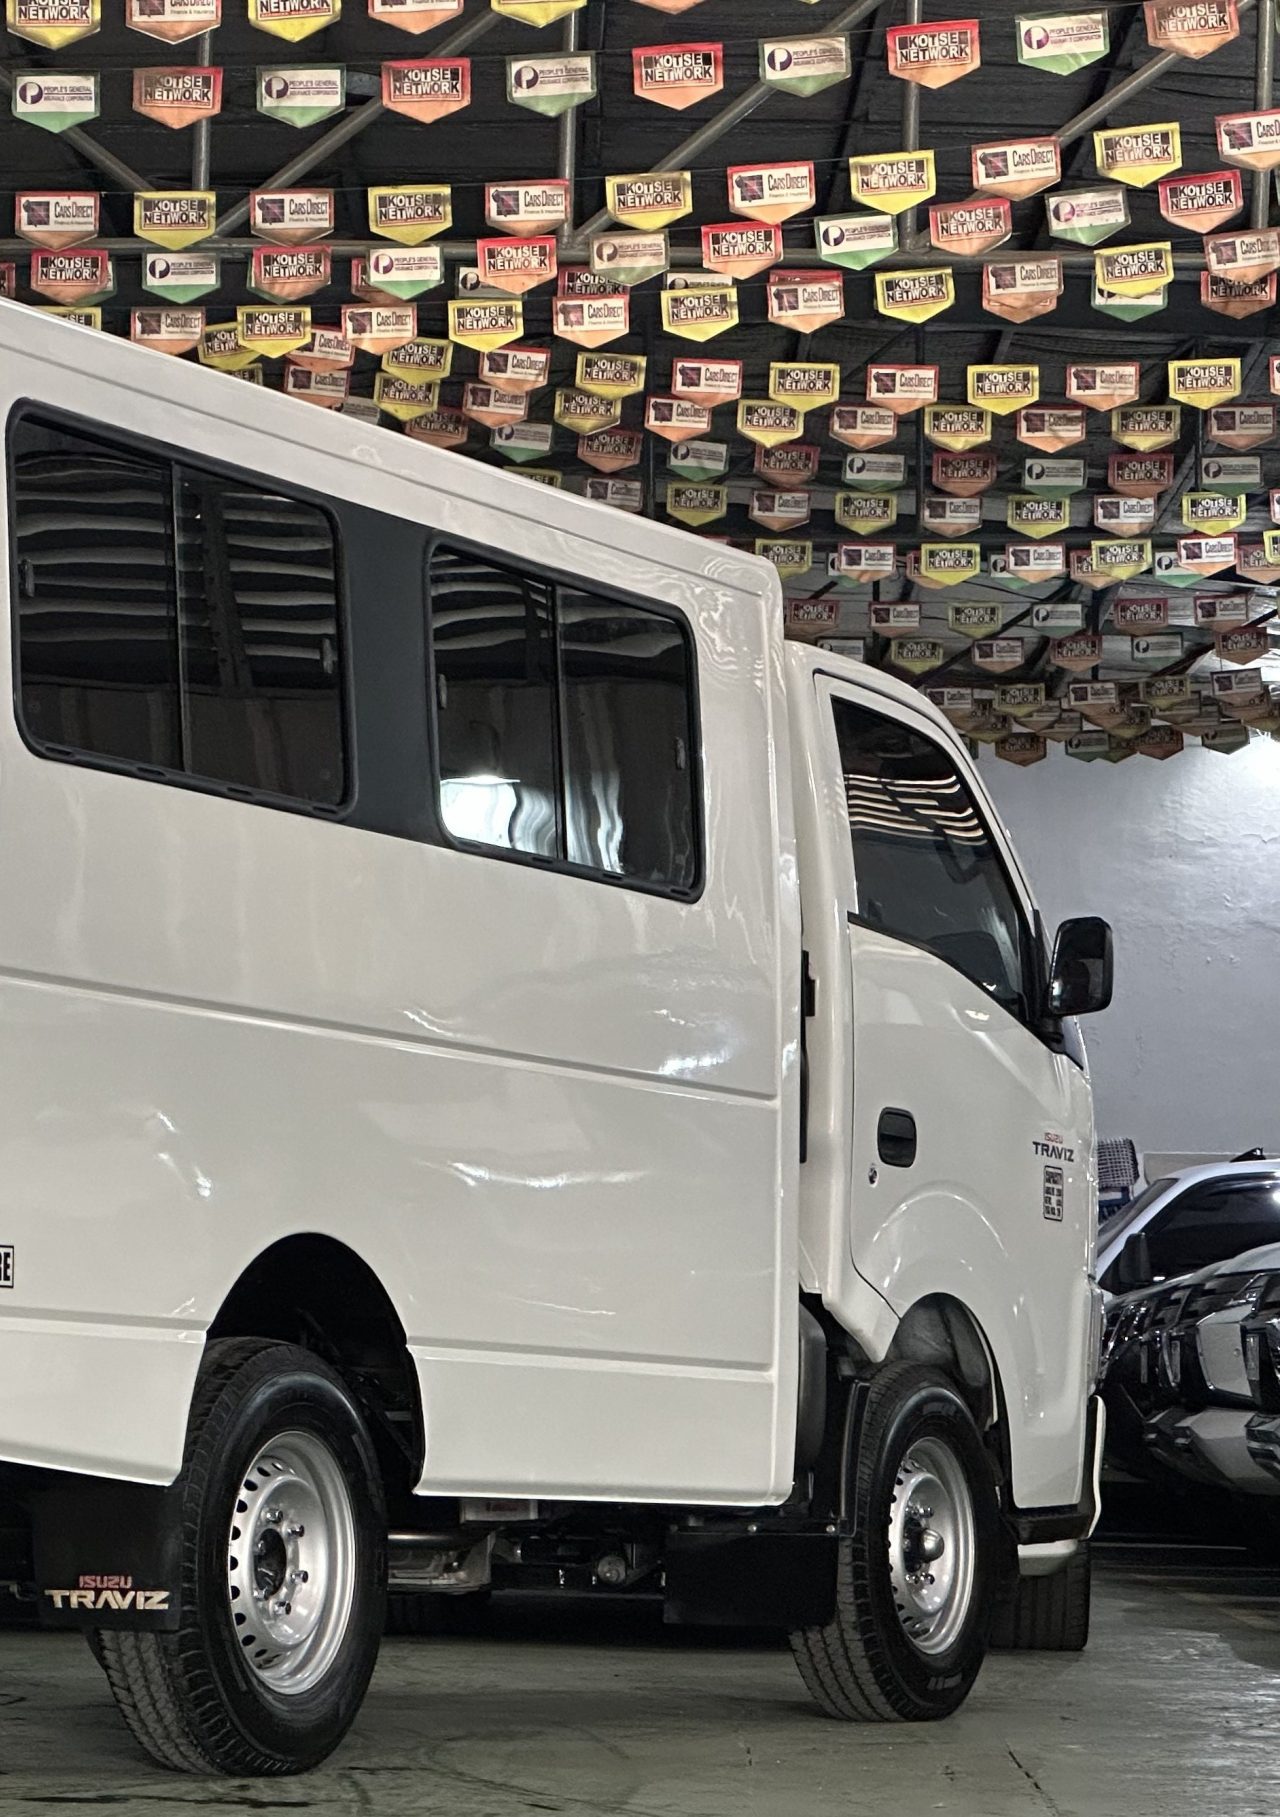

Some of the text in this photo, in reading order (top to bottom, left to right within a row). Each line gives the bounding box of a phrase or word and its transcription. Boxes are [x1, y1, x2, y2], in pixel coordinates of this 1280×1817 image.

[19, 5, 89, 19] NETWORK
[259, 0, 329, 13] NETWORK
[1168, 3, 1217, 18] KOTSE
[1158, 14, 1228, 31] NETWORK
[908, 32, 957, 47] KOTSE
[654, 54, 702, 67] KOTSE
[900, 46, 967, 63] NETWORK
[403, 68, 451, 82] KOTSE
[645, 66, 712, 82] NETWORK
[154, 75, 202, 87] KOTSE
[145, 88, 210, 100] NETWORK
[393, 82, 459, 96] NETWORK
[1113, 133, 1161, 148] KOTSE
[1105, 146, 1170, 162] NETWORK
[871, 161, 915, 175] KOTSE
[861, 173, 925, 188] NETWORK
[626, 181, 672, 194] KOTSE
[1178, 182, 1224, 197] KOTSE
[154, 200, 198, 212] KOTSE
[387, 193, 431, 207] KOTSE
[617, 192, 681, 207] NETWORK
[1171, 194, 1232, 209] NETWORK
[144, 211, 206, 223] NETWORK
[379, 204, 442, 220] NETWORK
[950, 208, 993, 223] KOTSE
[941, 218, 1002, 235] NETWORK
[721, 232, 763, 243] KOTSE
[496, 245, 539, 257] KOTSE
[713, 242, 772, 255] NETWORK
[48, 257, 91, 268] KOTSE
[272, 254, 315, 265] KOTSE
[488, 256, 547, 270] NETWORK
[1113, 251, 1155, 264] KOTSE
[41, 268, 98, 279] NETWORK
[263, 264, 322, 277] NETWORK
[1106, 262, 1163, 277] NETWORK
[894, 278, 936, 290] KOTSE
[1211, 284, 1267, 297] NETWORK
[678, 295, 719, 308] KOTSE
[886, 288, 944, 302] NETWORK
[254, 312, 295, 323] KOTSE
[464, 306, 506, 318] KOTSE
[671, 305, 728, 320] NETWORK
[246, 322, 302, 335] NETWORK
[457, 316, 513, 329] NETWORK
[786, 370, 824, 380] KOTSE
[985, 372, 1023, 384] KOTSE
[1186, 366, 1225, 377] KOTSE
[976, 382, 1030, 395] NETWORK
[1178, 376, 1232, 388] NETWORK
[1032, 1141, 1074, 1162] TRAVIZ
[79, 1575, 133, 1589] ISUZU
[44, 1589, 170, 1610] TRAVIZ
